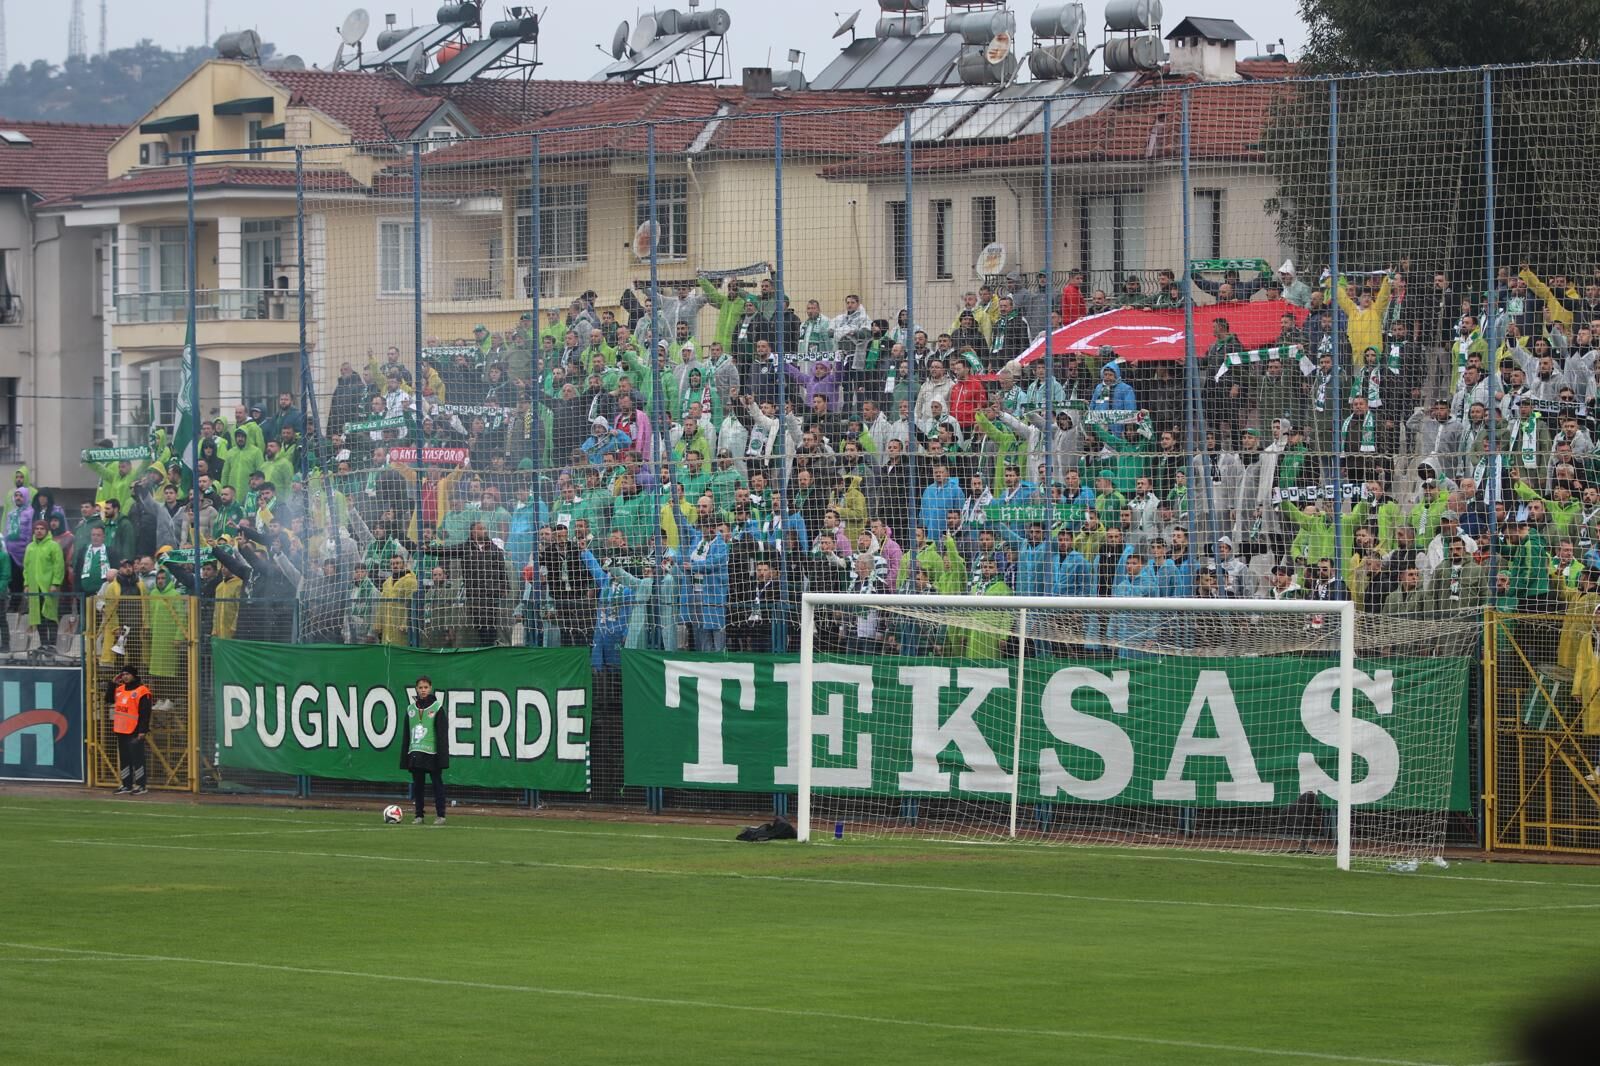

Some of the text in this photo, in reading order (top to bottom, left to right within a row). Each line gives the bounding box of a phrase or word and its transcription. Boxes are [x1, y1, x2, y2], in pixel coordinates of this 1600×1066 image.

[1281, 485, 1361, 499] BURSASOR
[222, 684, 398, 751] PUGNO
[664, 659, 1401, 804] TEKSAS
